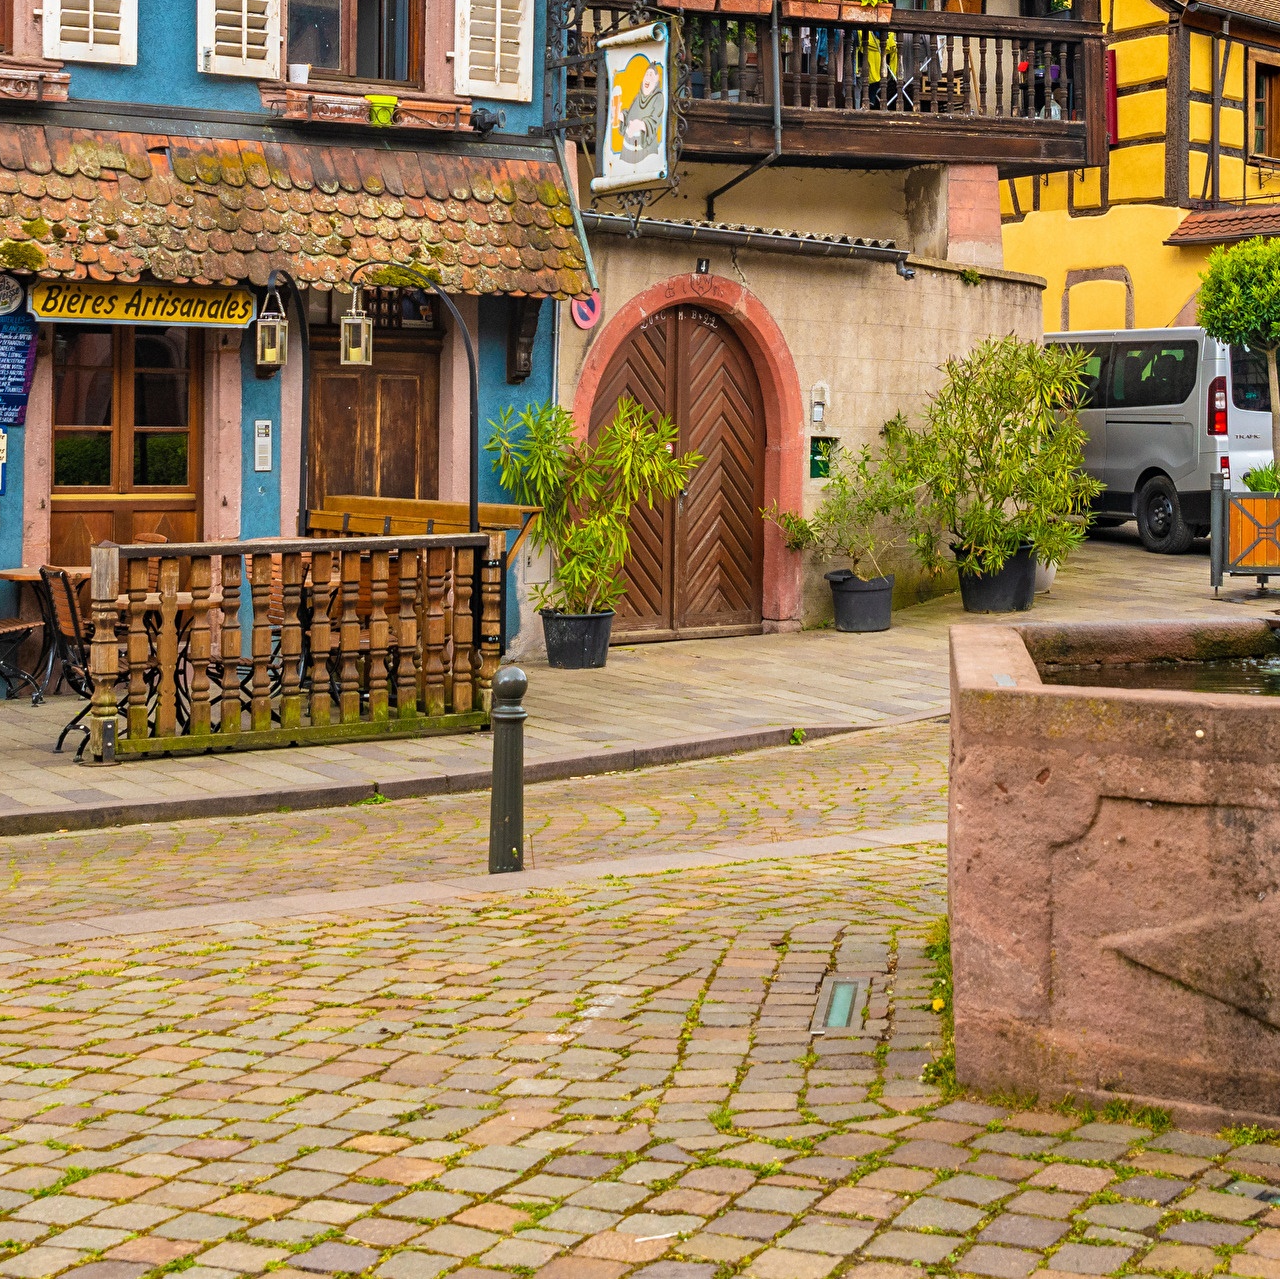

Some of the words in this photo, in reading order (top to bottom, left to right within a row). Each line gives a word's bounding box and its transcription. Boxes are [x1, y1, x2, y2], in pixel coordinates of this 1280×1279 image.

[700, 260, 706, 272] 4
[41, 284, 118, 315] Bières
[124, 288, 252, 320] Artisanales
